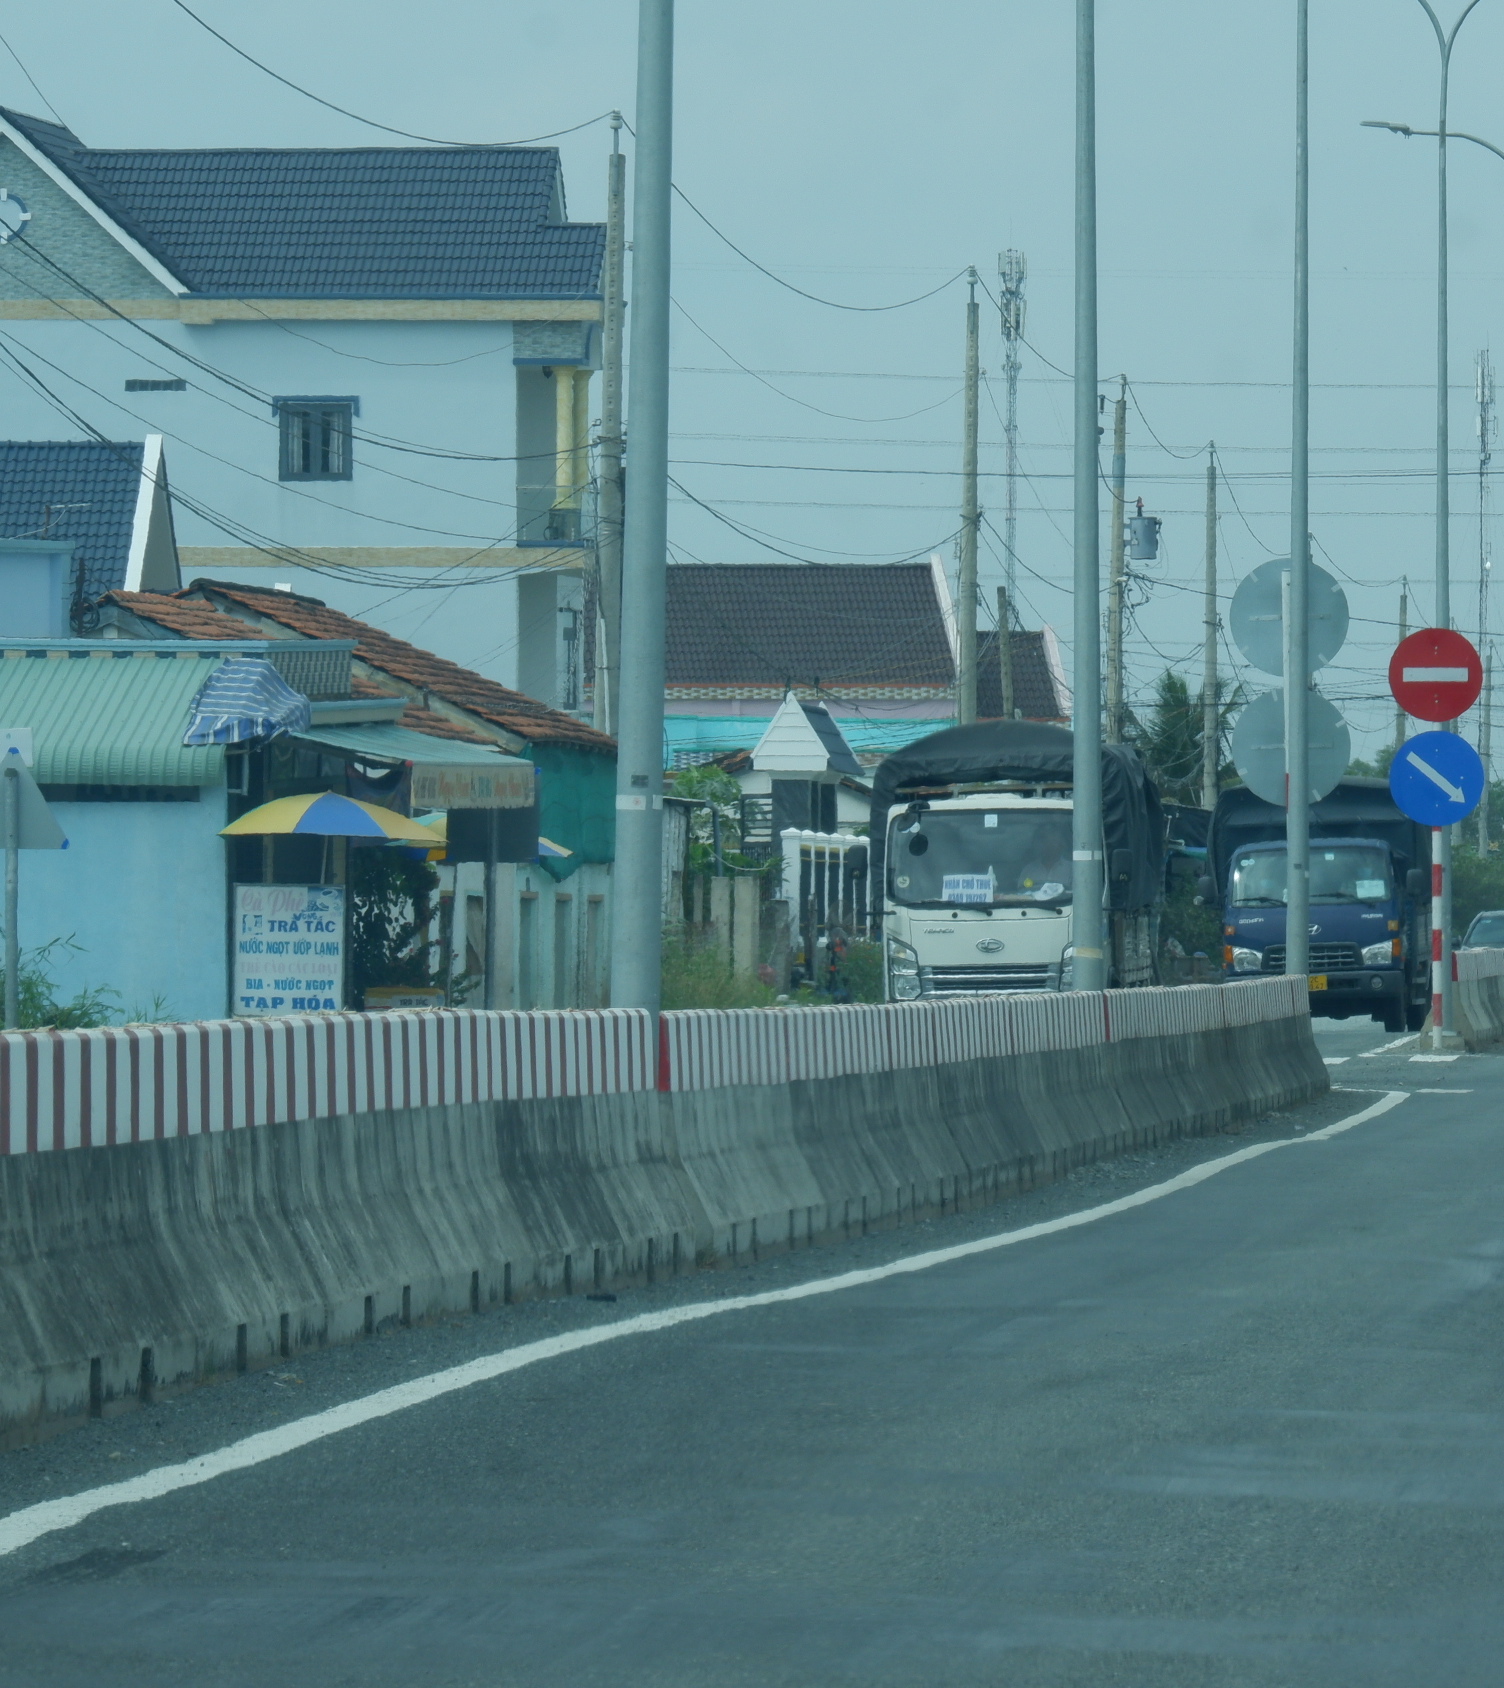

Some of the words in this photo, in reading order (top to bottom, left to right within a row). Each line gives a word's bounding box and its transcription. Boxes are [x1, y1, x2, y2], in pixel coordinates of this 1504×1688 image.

[304, 916, 336, 932] TẮC
[239, 937, 264, 954] NƯỚC
[266, 941, 291, 957] NGỌT
[293, 938, 312, 955] ƯỚP
[314, 942, 340, 957] LẠNH
[245, 978, 264, 990] BIA
[274, 977, 303, 991] NƯỚC
[305, 979, 335, 993] NGỌT
[240, 996, 285, 1012] TẠP
[291, 994, 336, 1011] HÓA
